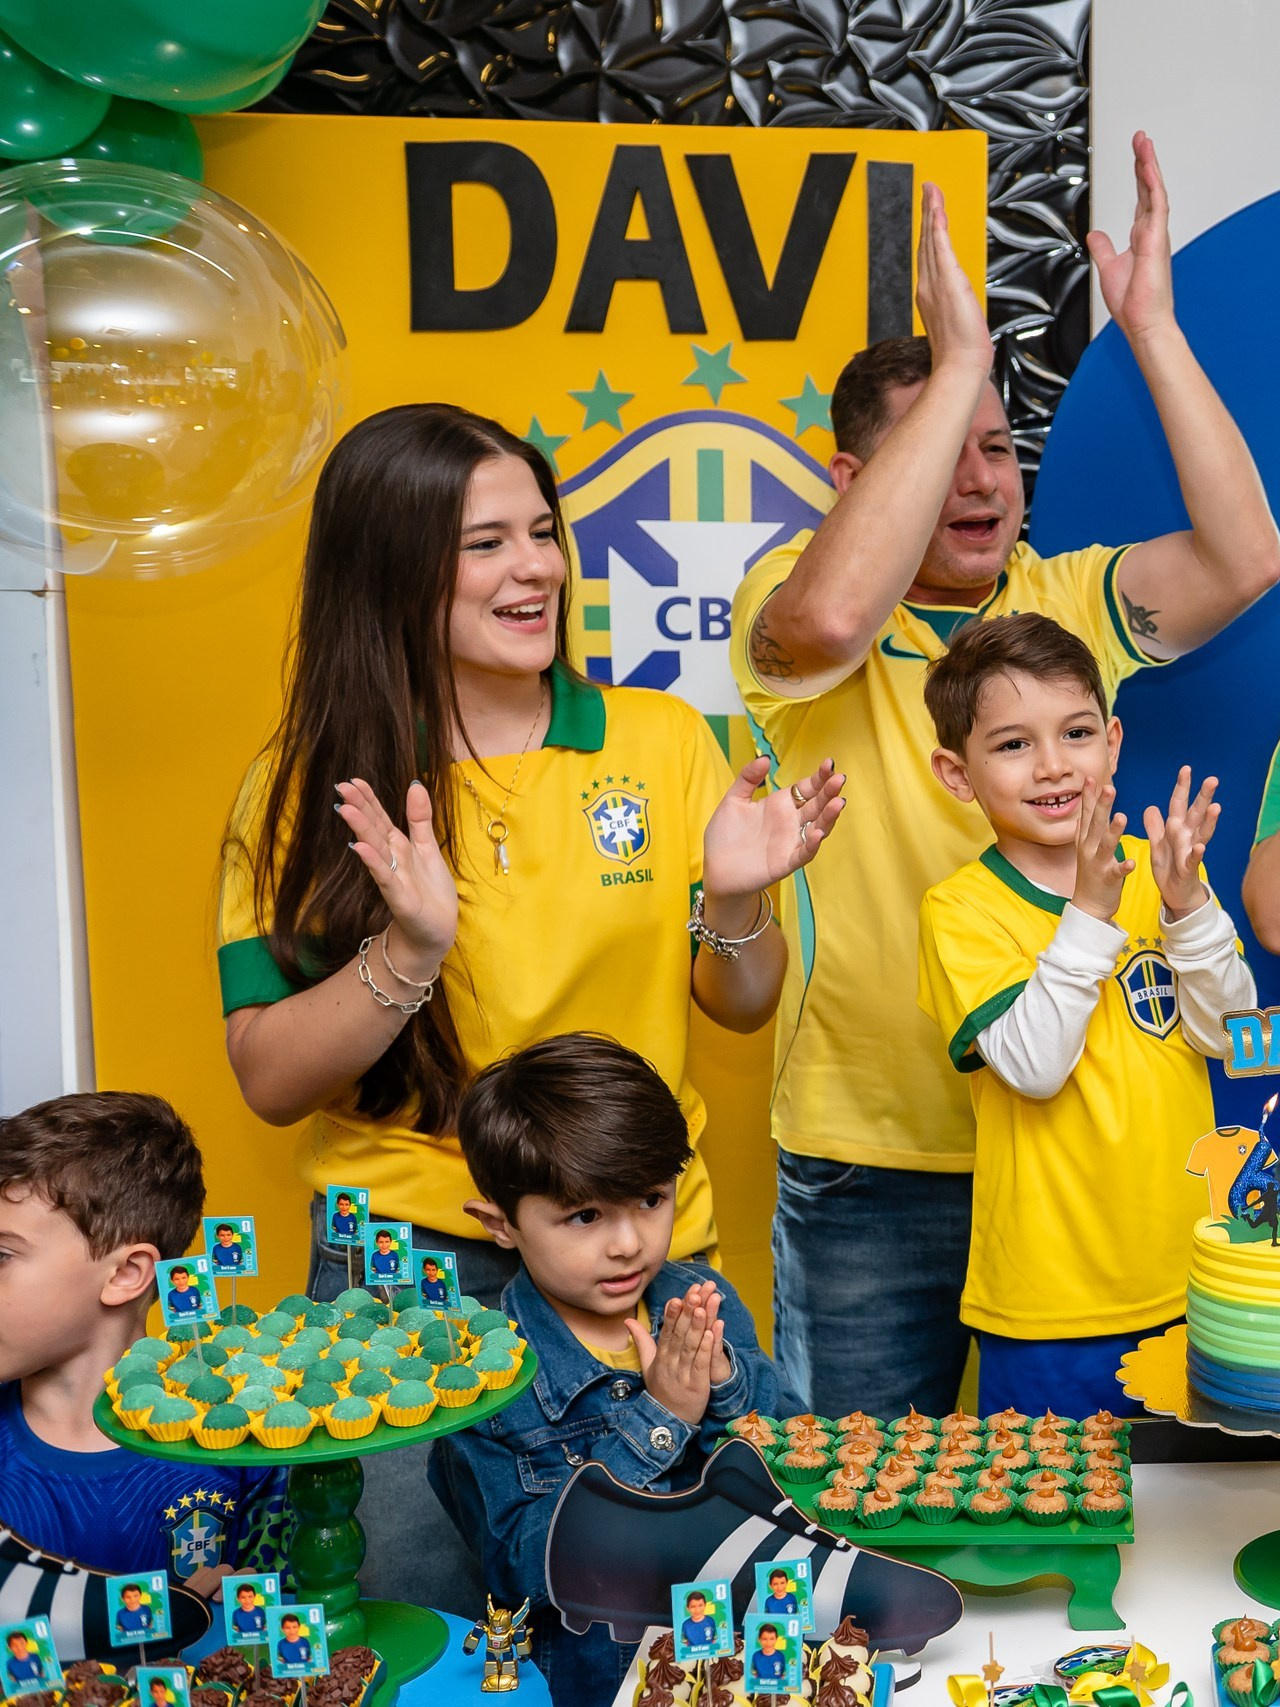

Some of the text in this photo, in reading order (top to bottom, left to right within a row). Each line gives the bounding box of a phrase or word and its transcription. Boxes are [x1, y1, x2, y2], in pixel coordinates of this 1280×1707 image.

[403, 139, 914, 346] DAVI
[656, 596, 731, 641] CB
[609, 818, 630, 830] CBF
[600, 868, 654, 887] BRASIL
[1137, 987, 1168, 1000] BRASIL
[187, 1540, 211, 1552] CBF
